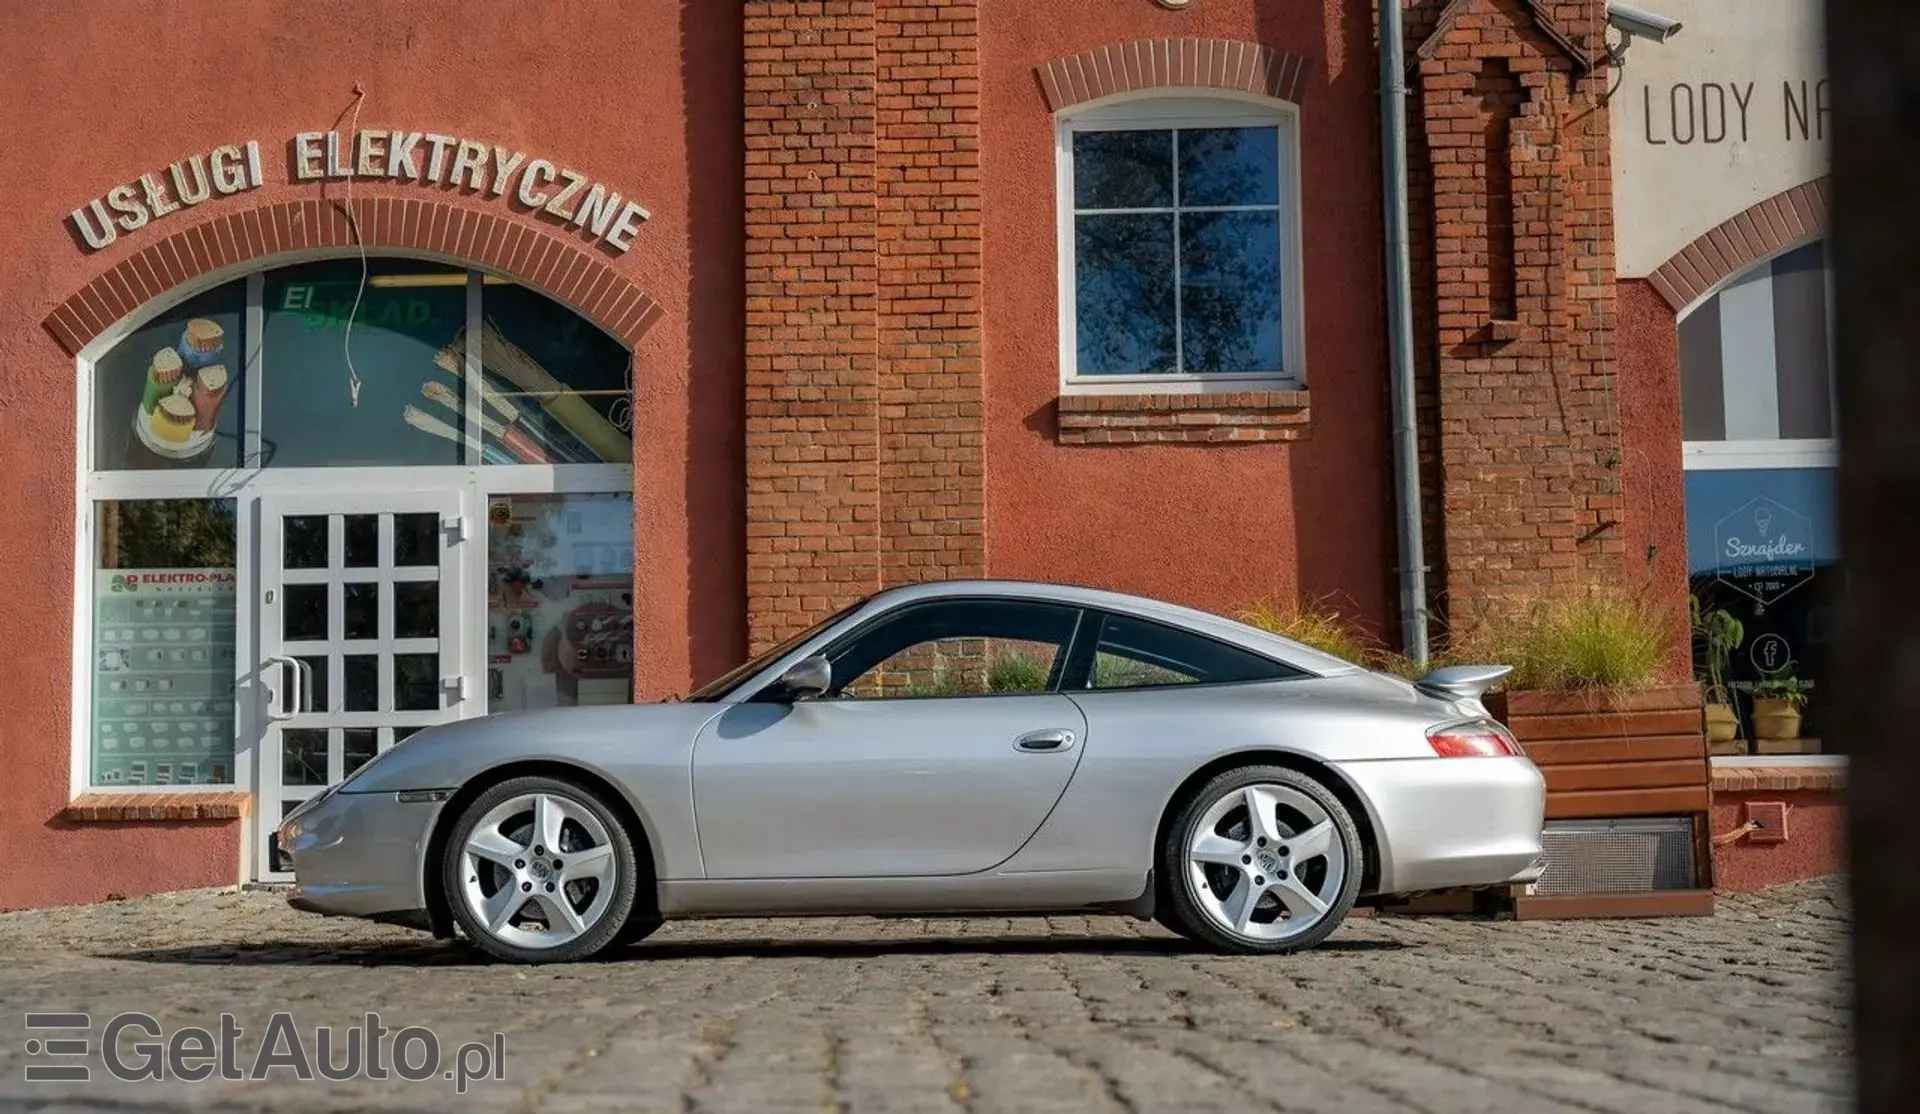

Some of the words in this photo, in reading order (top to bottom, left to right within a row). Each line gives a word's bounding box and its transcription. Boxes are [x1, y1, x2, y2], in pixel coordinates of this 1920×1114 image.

[1643, 81, 1755, 145] LODY
[70, 139, 264, 250] USŁUGI
[296, 130, 651, 253] ELEKTRYCZNE
[1725, 534, 1805, 561] Sznajder
